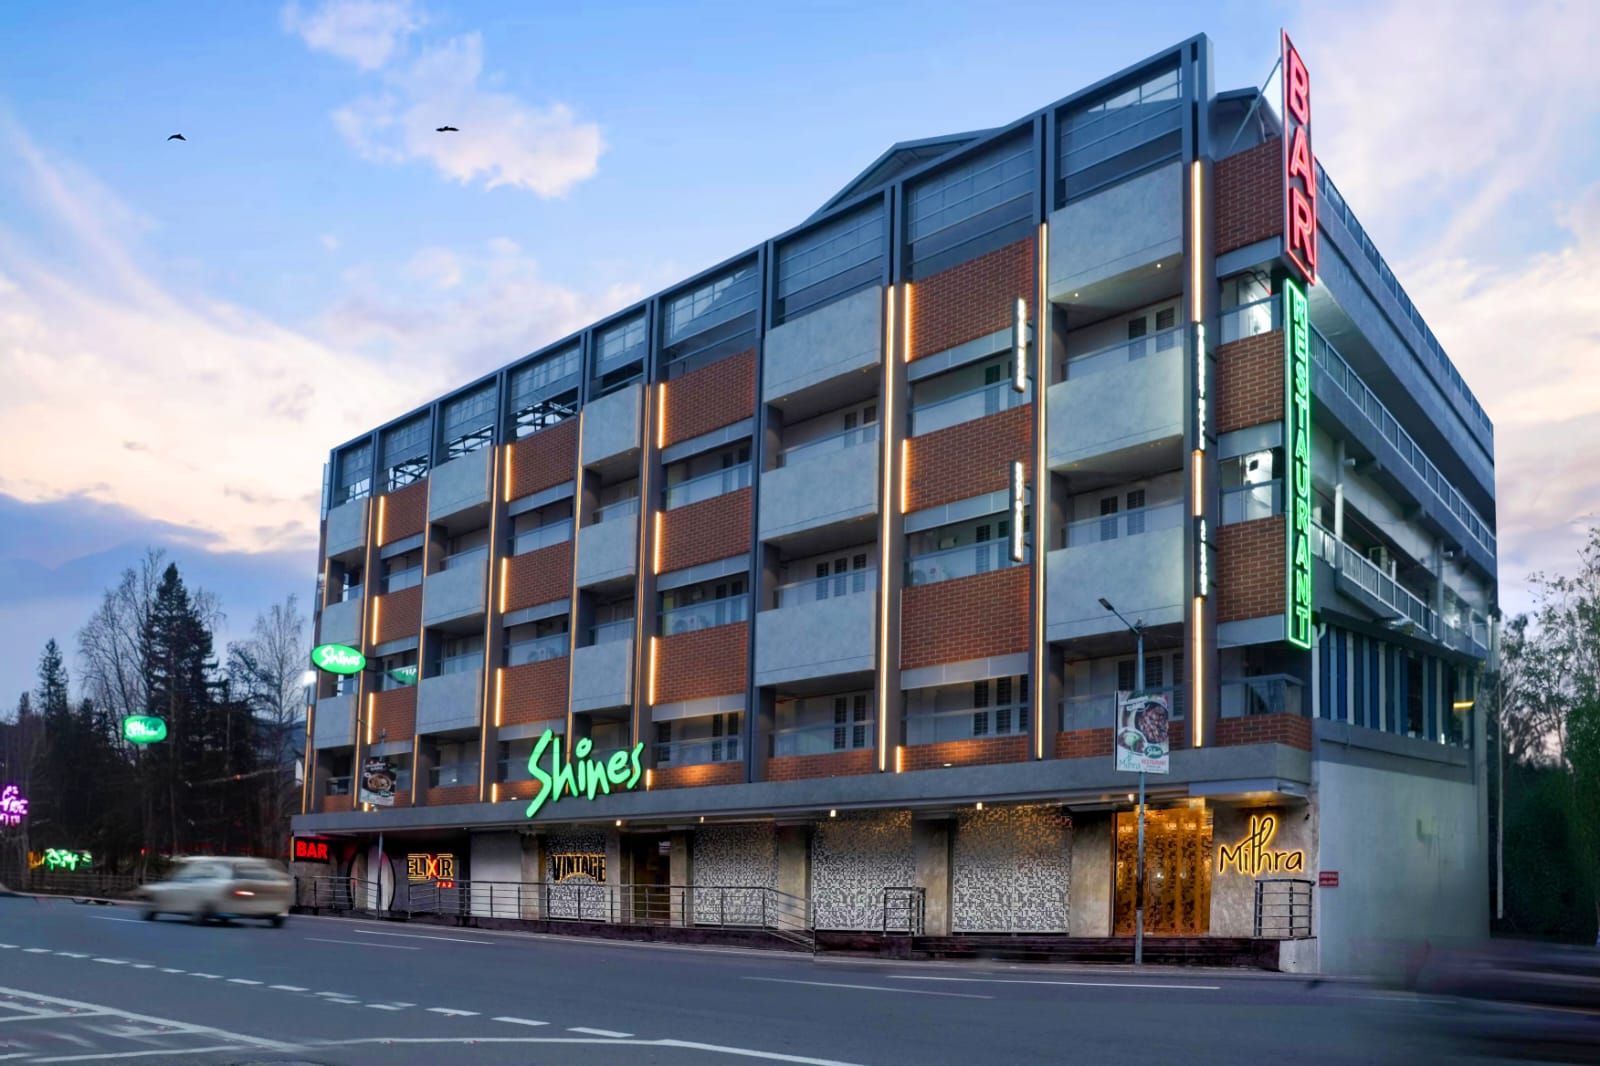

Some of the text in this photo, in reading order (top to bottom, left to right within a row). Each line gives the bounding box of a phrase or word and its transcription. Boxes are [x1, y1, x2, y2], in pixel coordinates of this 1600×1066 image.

[1288, 48, 1314, 265] BAR
[1293, 288, 1310, 640] RESTAURANT
[526, 728, 644, 818] Shines
[295, 839, 329, 859] BAR
[552, 854, 607, 882] VINTAGE
[1218, 814, 1305, 876] Mithra
